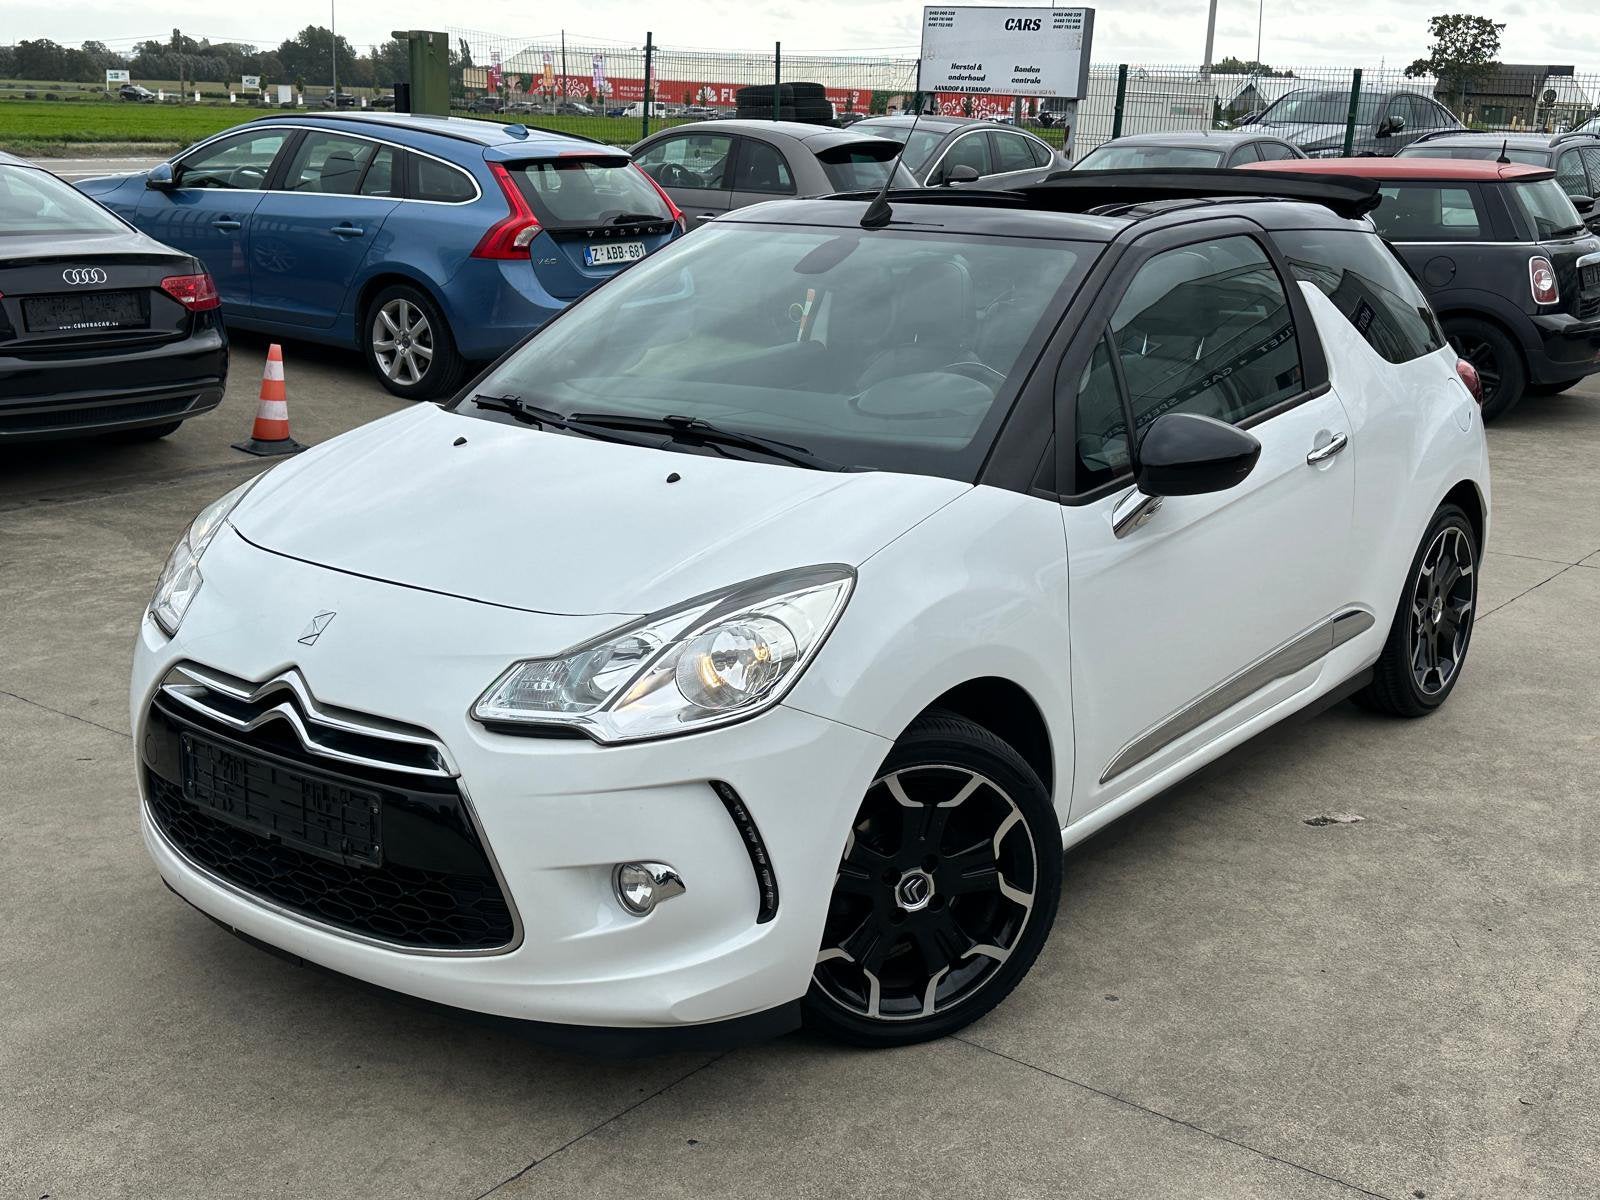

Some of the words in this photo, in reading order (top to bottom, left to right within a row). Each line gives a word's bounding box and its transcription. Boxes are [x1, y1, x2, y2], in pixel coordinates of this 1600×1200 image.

[1004, 18, 1042, 31] CARS
[951, 63, 976, 71] Herstel
[1014, 65, 1041, 73] Banden
[948, 74, 986, 82] onderhoud
[1011, 76, 1041, 84] centrale
